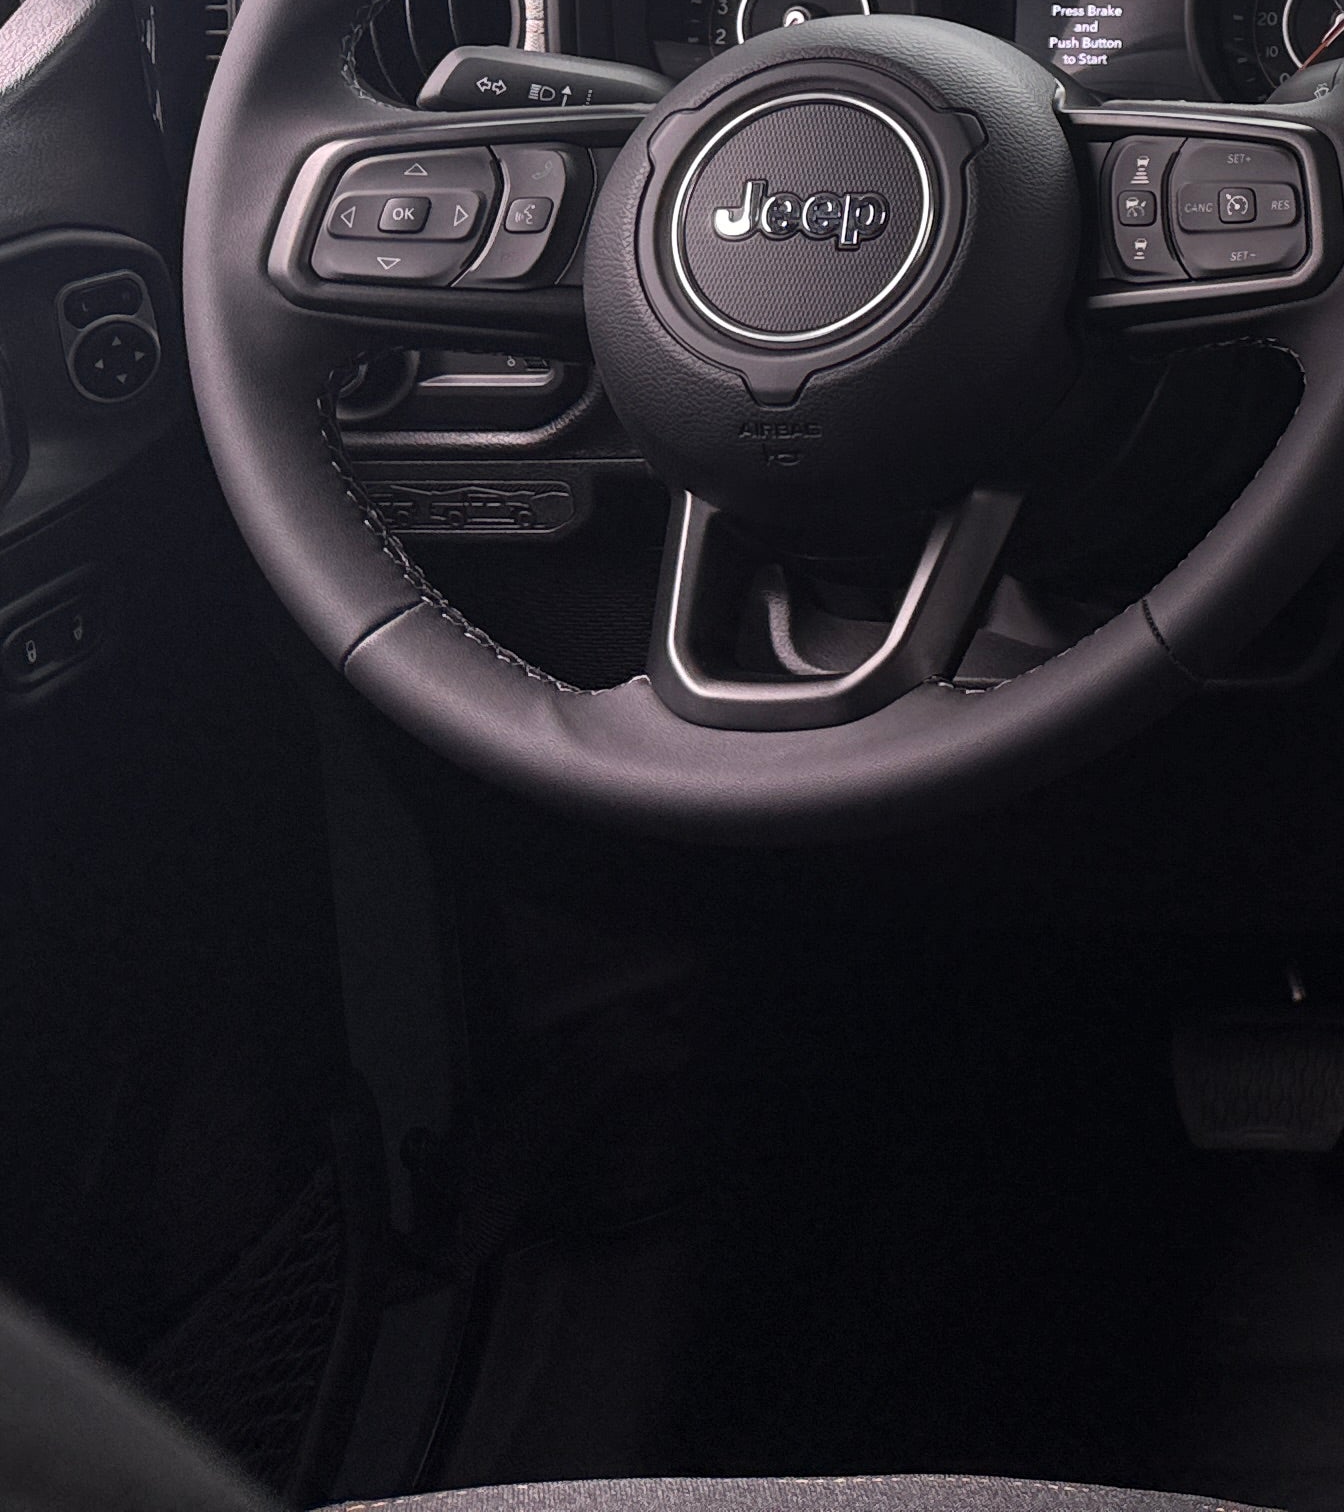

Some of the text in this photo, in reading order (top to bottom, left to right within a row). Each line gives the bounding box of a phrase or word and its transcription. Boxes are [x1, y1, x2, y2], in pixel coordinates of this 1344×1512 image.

[717, 0, 729, 15] 3
[1052, 5, 1122, 17] Press Brake
[1258, 12, 1279, 26] 20
[1074, 21, 1099, 33] and
[715, 29, 727, 45] 2
[1049, 37, 1122, 49] Push Button
[1265, 46, 1279, 58] 10
[1063, 54, 1108, 65] to Start
[1271, 200, 1290, 211] RES
[392, 208, 415, 221] OK
[714, 179, 889, 251] Jeep
[739, 423, 823, 439] AIRBAG
